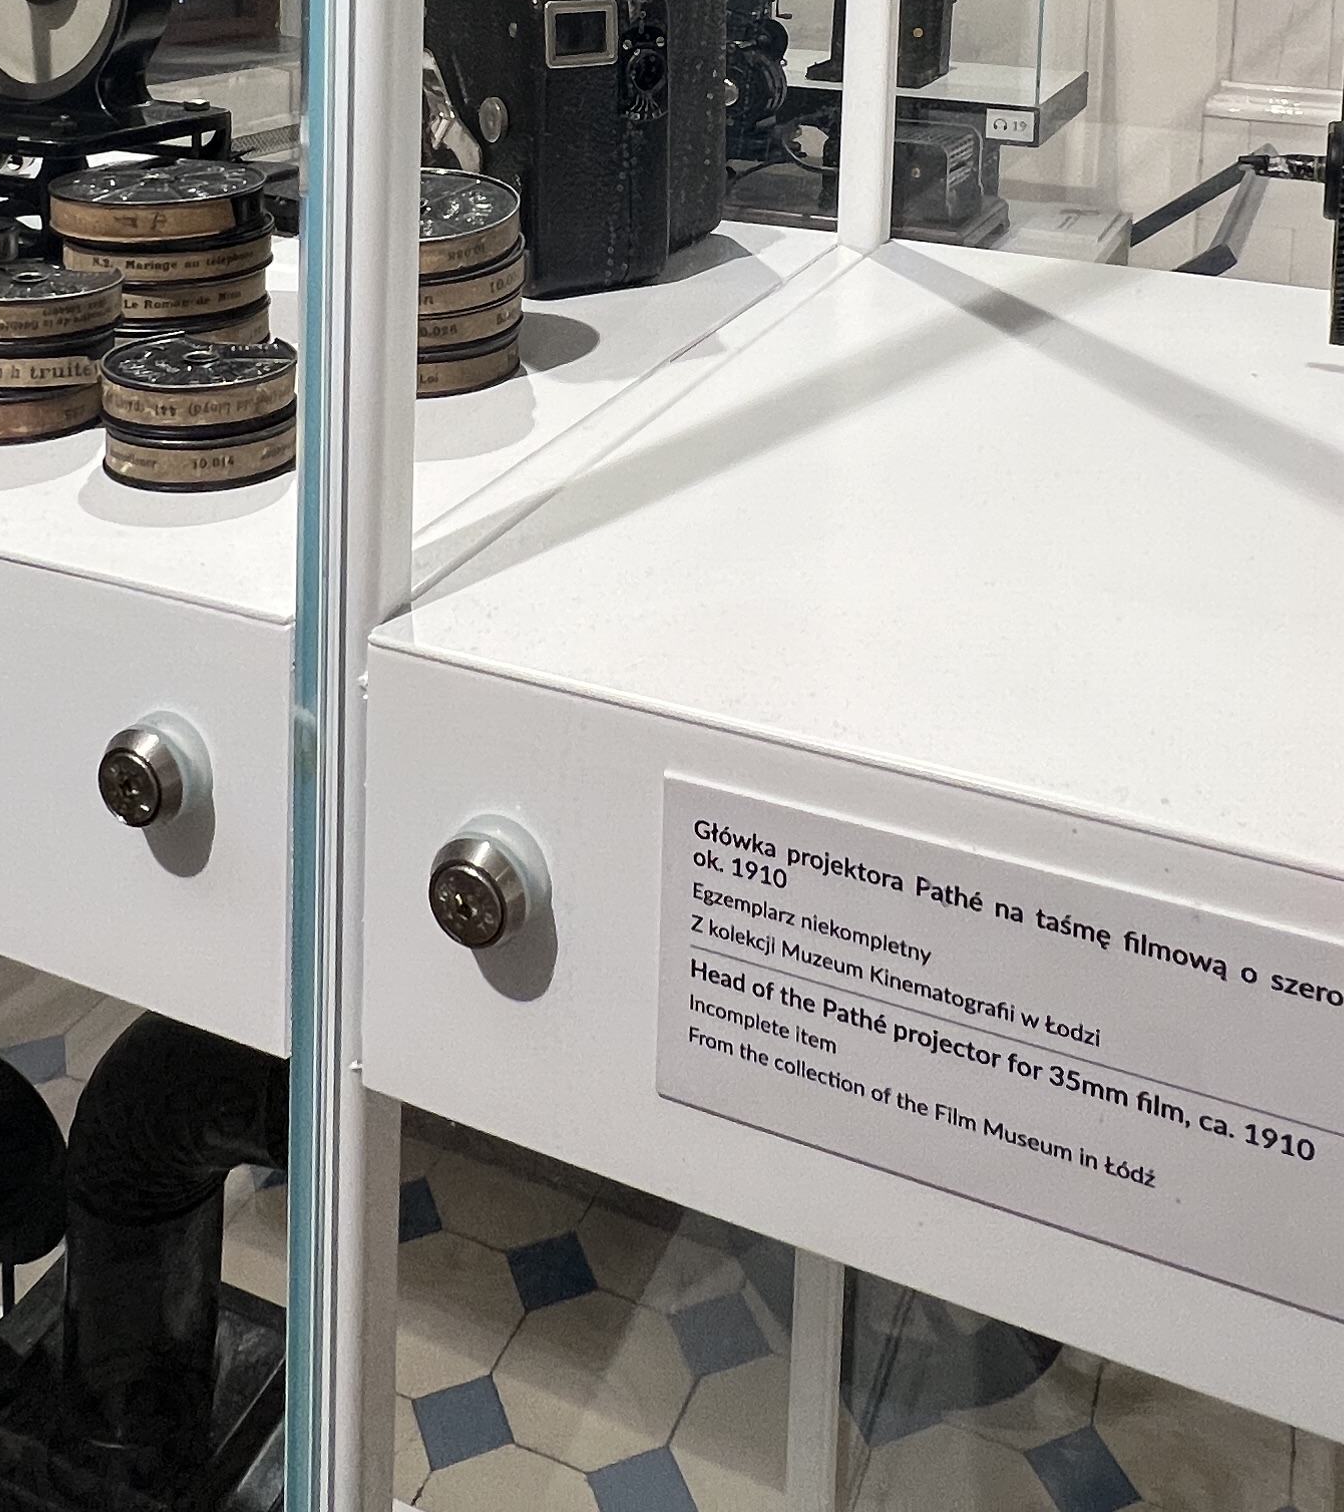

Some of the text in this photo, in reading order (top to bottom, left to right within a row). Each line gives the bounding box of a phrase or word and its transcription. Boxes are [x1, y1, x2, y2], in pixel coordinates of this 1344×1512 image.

[1012, 120, 1028, 132] 19
[123, 299, 139, 310] Le
[144, 297, 190, 310] Roman
[196, 295, 212, 307] de
[125, 260, 178, 273] Mariage
[184, 259, 200, 269] au
[693, 849, 787, 889] ok. 1910
[694, 820, 776, 858] Główka
[787, 848, 903, 892] projektora
[916, 876, 983, 912] Pathé
[995, 902, 1023, 924] na
[1035, 908, 1111, 950] taśmę
[1123, 931, 1228, 982] filmową
[1241, 967, 1258, 984] o
[693, 881, 932, 966] Egzemplarz niekompletny
[691, 914, 1101, 1047] Z kolekcji Muzeum Kinematografii w Łodzi
[690, 993, 836, 1054] Incomplete item
[691, 958, 1315, 1161] Head of the Pathé projector for 35mm film, ca. 1910
[689, 1025, 1156, 1188] From the collection of the Film Museum in Łódź
